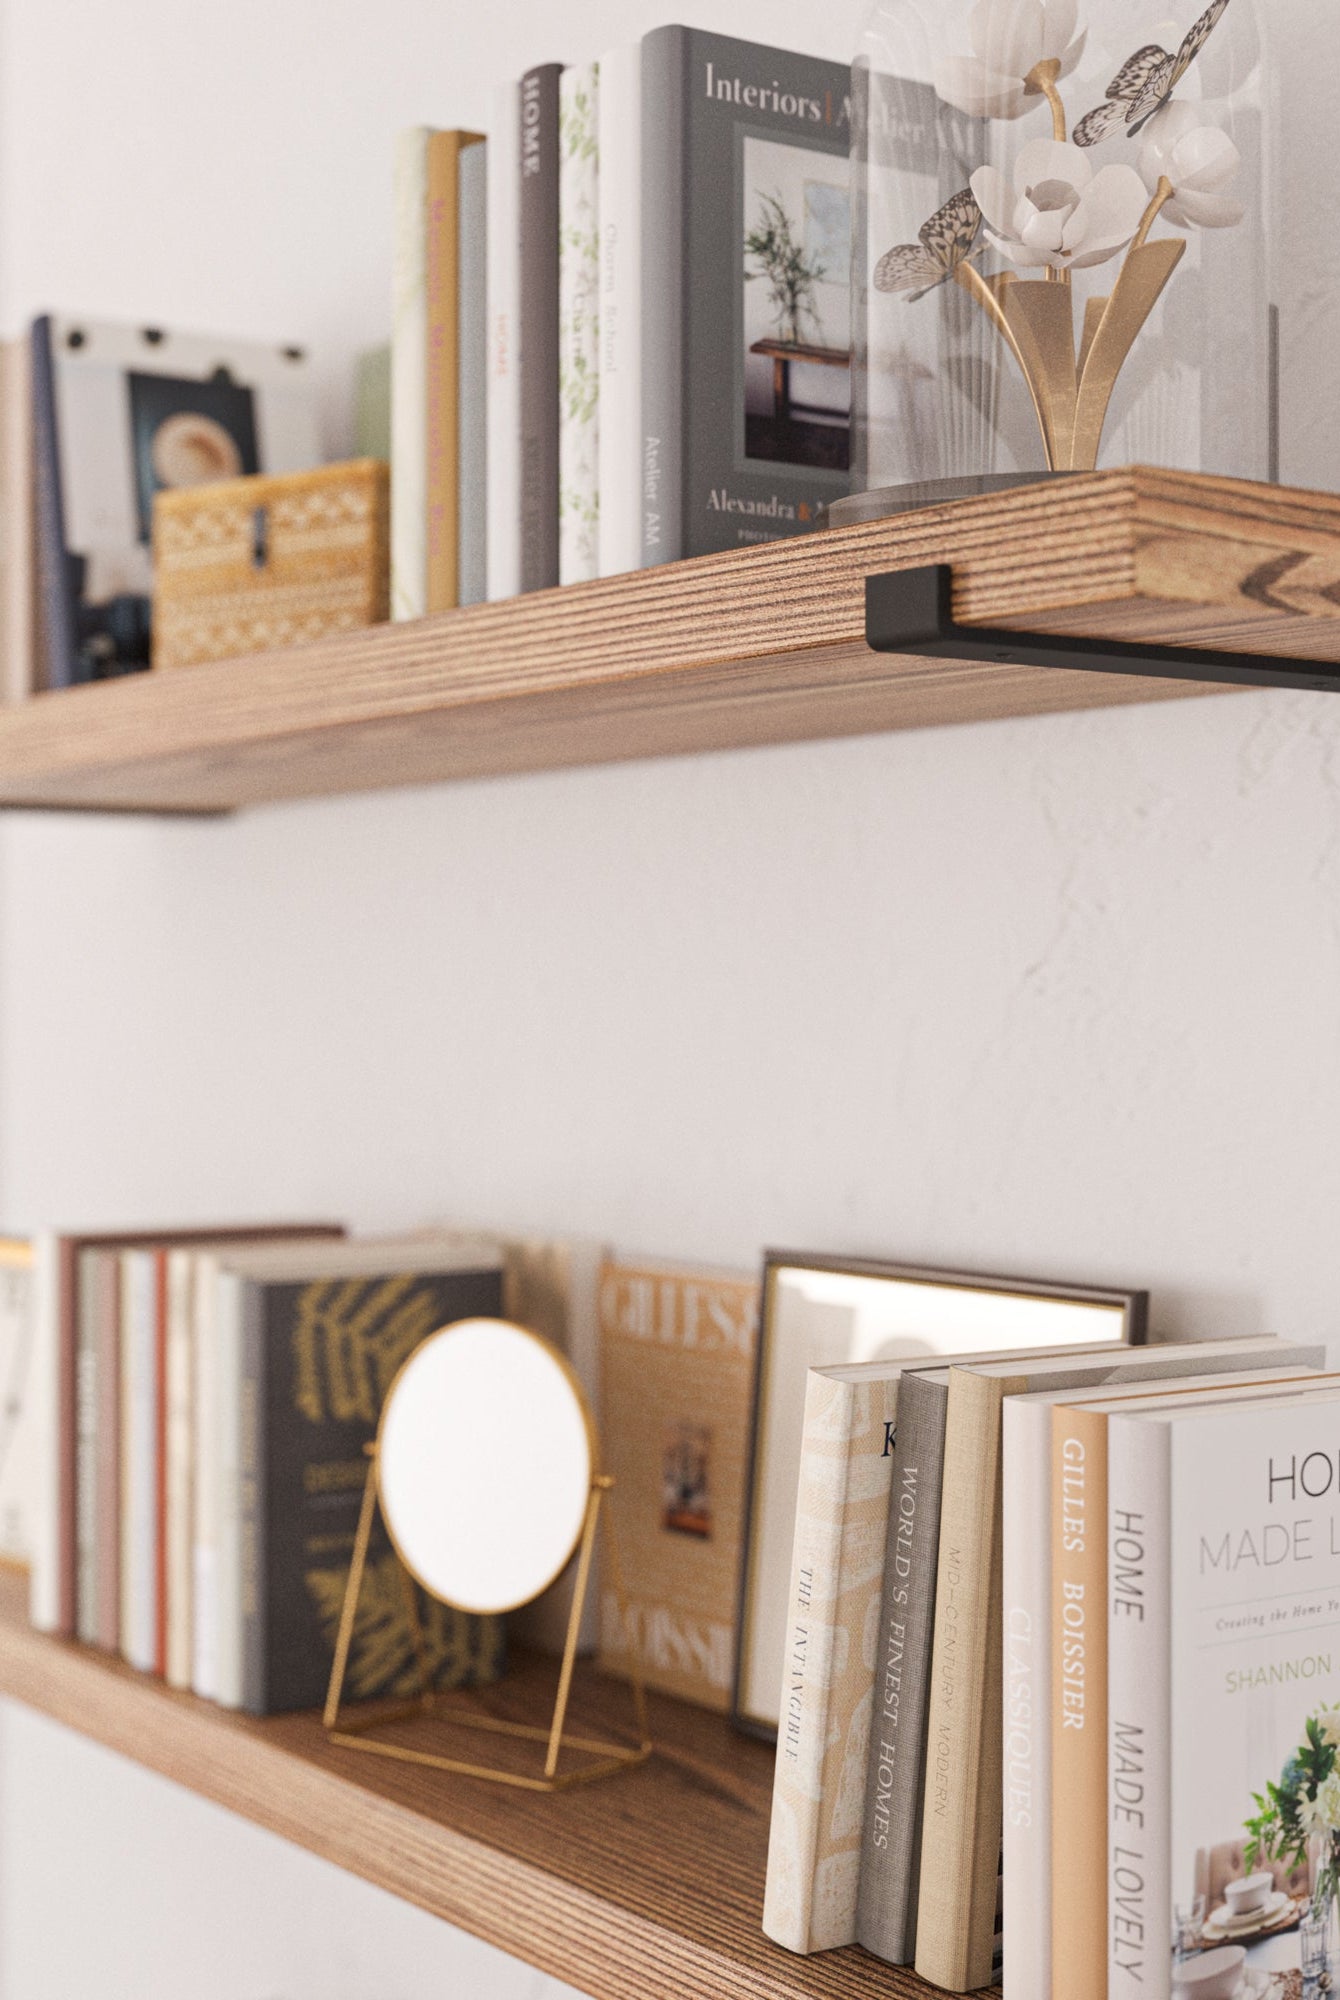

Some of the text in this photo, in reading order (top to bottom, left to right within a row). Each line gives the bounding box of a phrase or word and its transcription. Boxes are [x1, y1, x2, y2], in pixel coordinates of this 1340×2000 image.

[522, 76, 541, 179] HOME
[706, 62, 821, 122] Interiors
[645, 436, 661, 546] Atelier AM
[706, 488, 795, 520] Alexandra
[1268, 1448, 1340, 1504] HO
[1062, 1438, 1085, 1731] GILLES BOISSIER
[1200, 1518, 1314, 1576] MADE
[785, 1568, 813, 1764] THE INTANGIBLE
[873, 1467, 918, 1851] WORLD'S FINEST HOMES
[1215, 1615, 1265, 1632] Creating
[1270, 1608, 1288, 1622] the
[1292, 1604, 1323, 1618] Home
[1008, 1606, 1033, 1829] CLASSIQUES
[1225, 1652, 1333, 1694] SHANNON
[934, 1724, 951, 1818] MODERN
[1113, 1509, 1145, 1983] HOME MADE LOVELY
